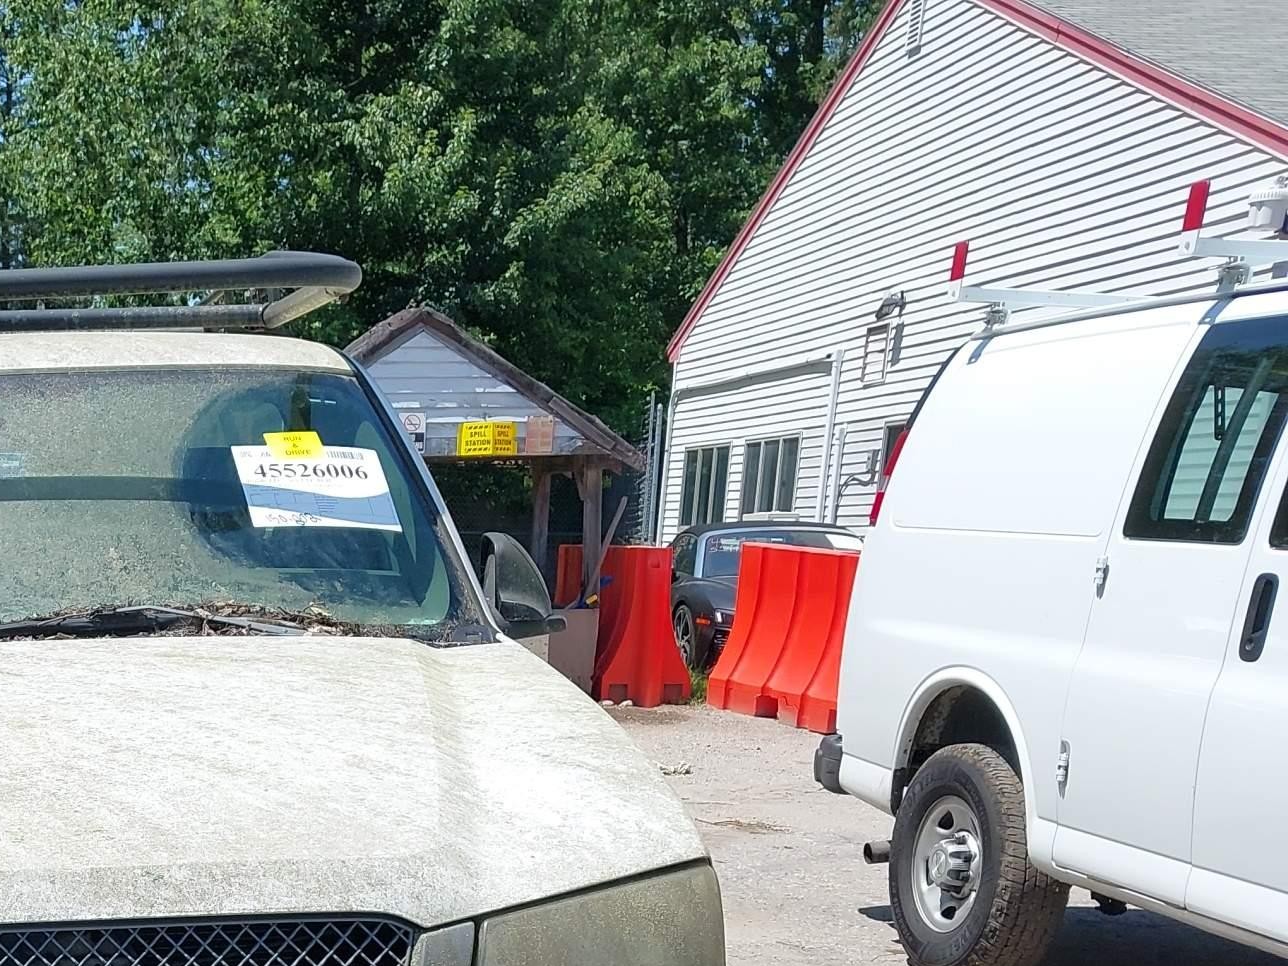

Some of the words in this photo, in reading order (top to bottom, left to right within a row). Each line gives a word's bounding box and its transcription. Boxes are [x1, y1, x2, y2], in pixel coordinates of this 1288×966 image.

[470, 430, 487, 438] SPILL
[465, 439, 491, 447] STATION
[254, 463, 368, 480] 45526006
